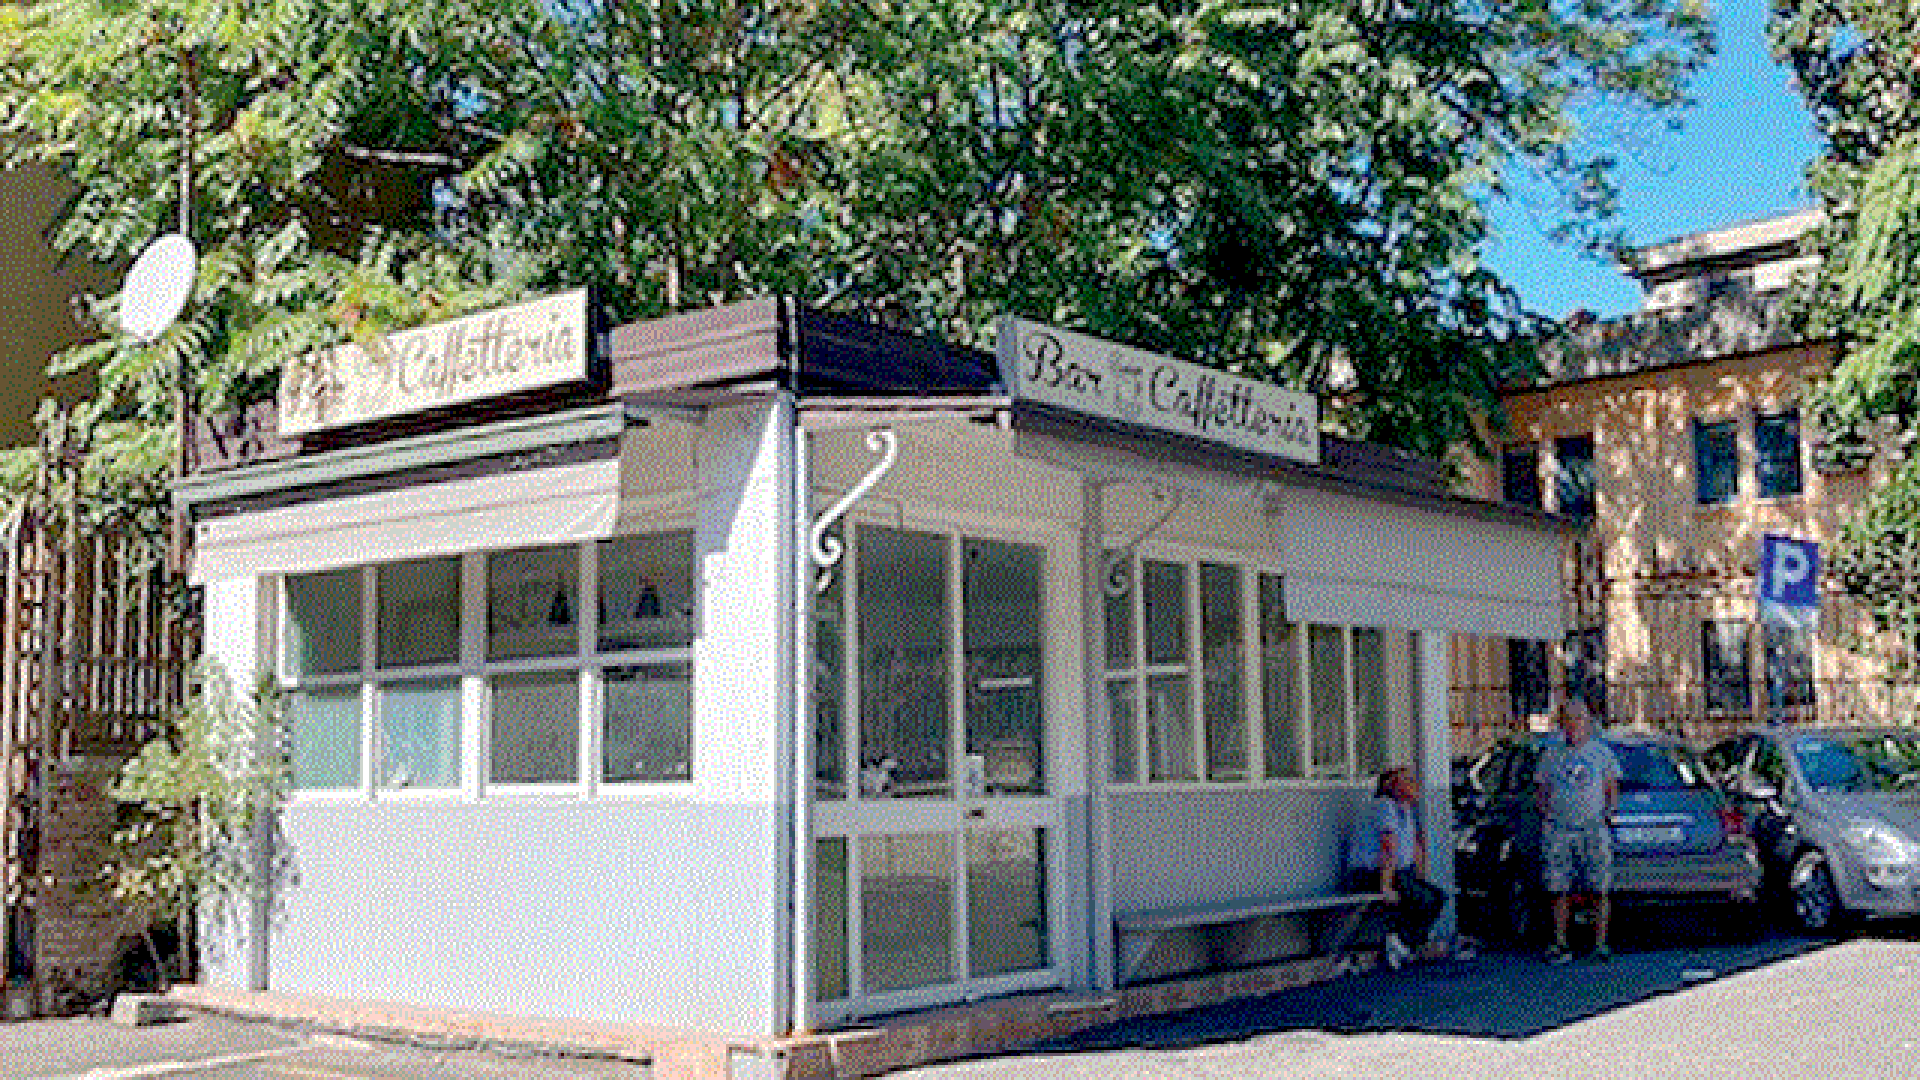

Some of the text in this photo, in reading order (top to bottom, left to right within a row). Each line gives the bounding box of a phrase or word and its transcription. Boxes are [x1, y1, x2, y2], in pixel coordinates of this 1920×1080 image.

[399, 314, 572, 394] Caffetteria
[1023, 330, 1312, 446] Bar Caffetteria
[1772, 542, 1810, 598] P
